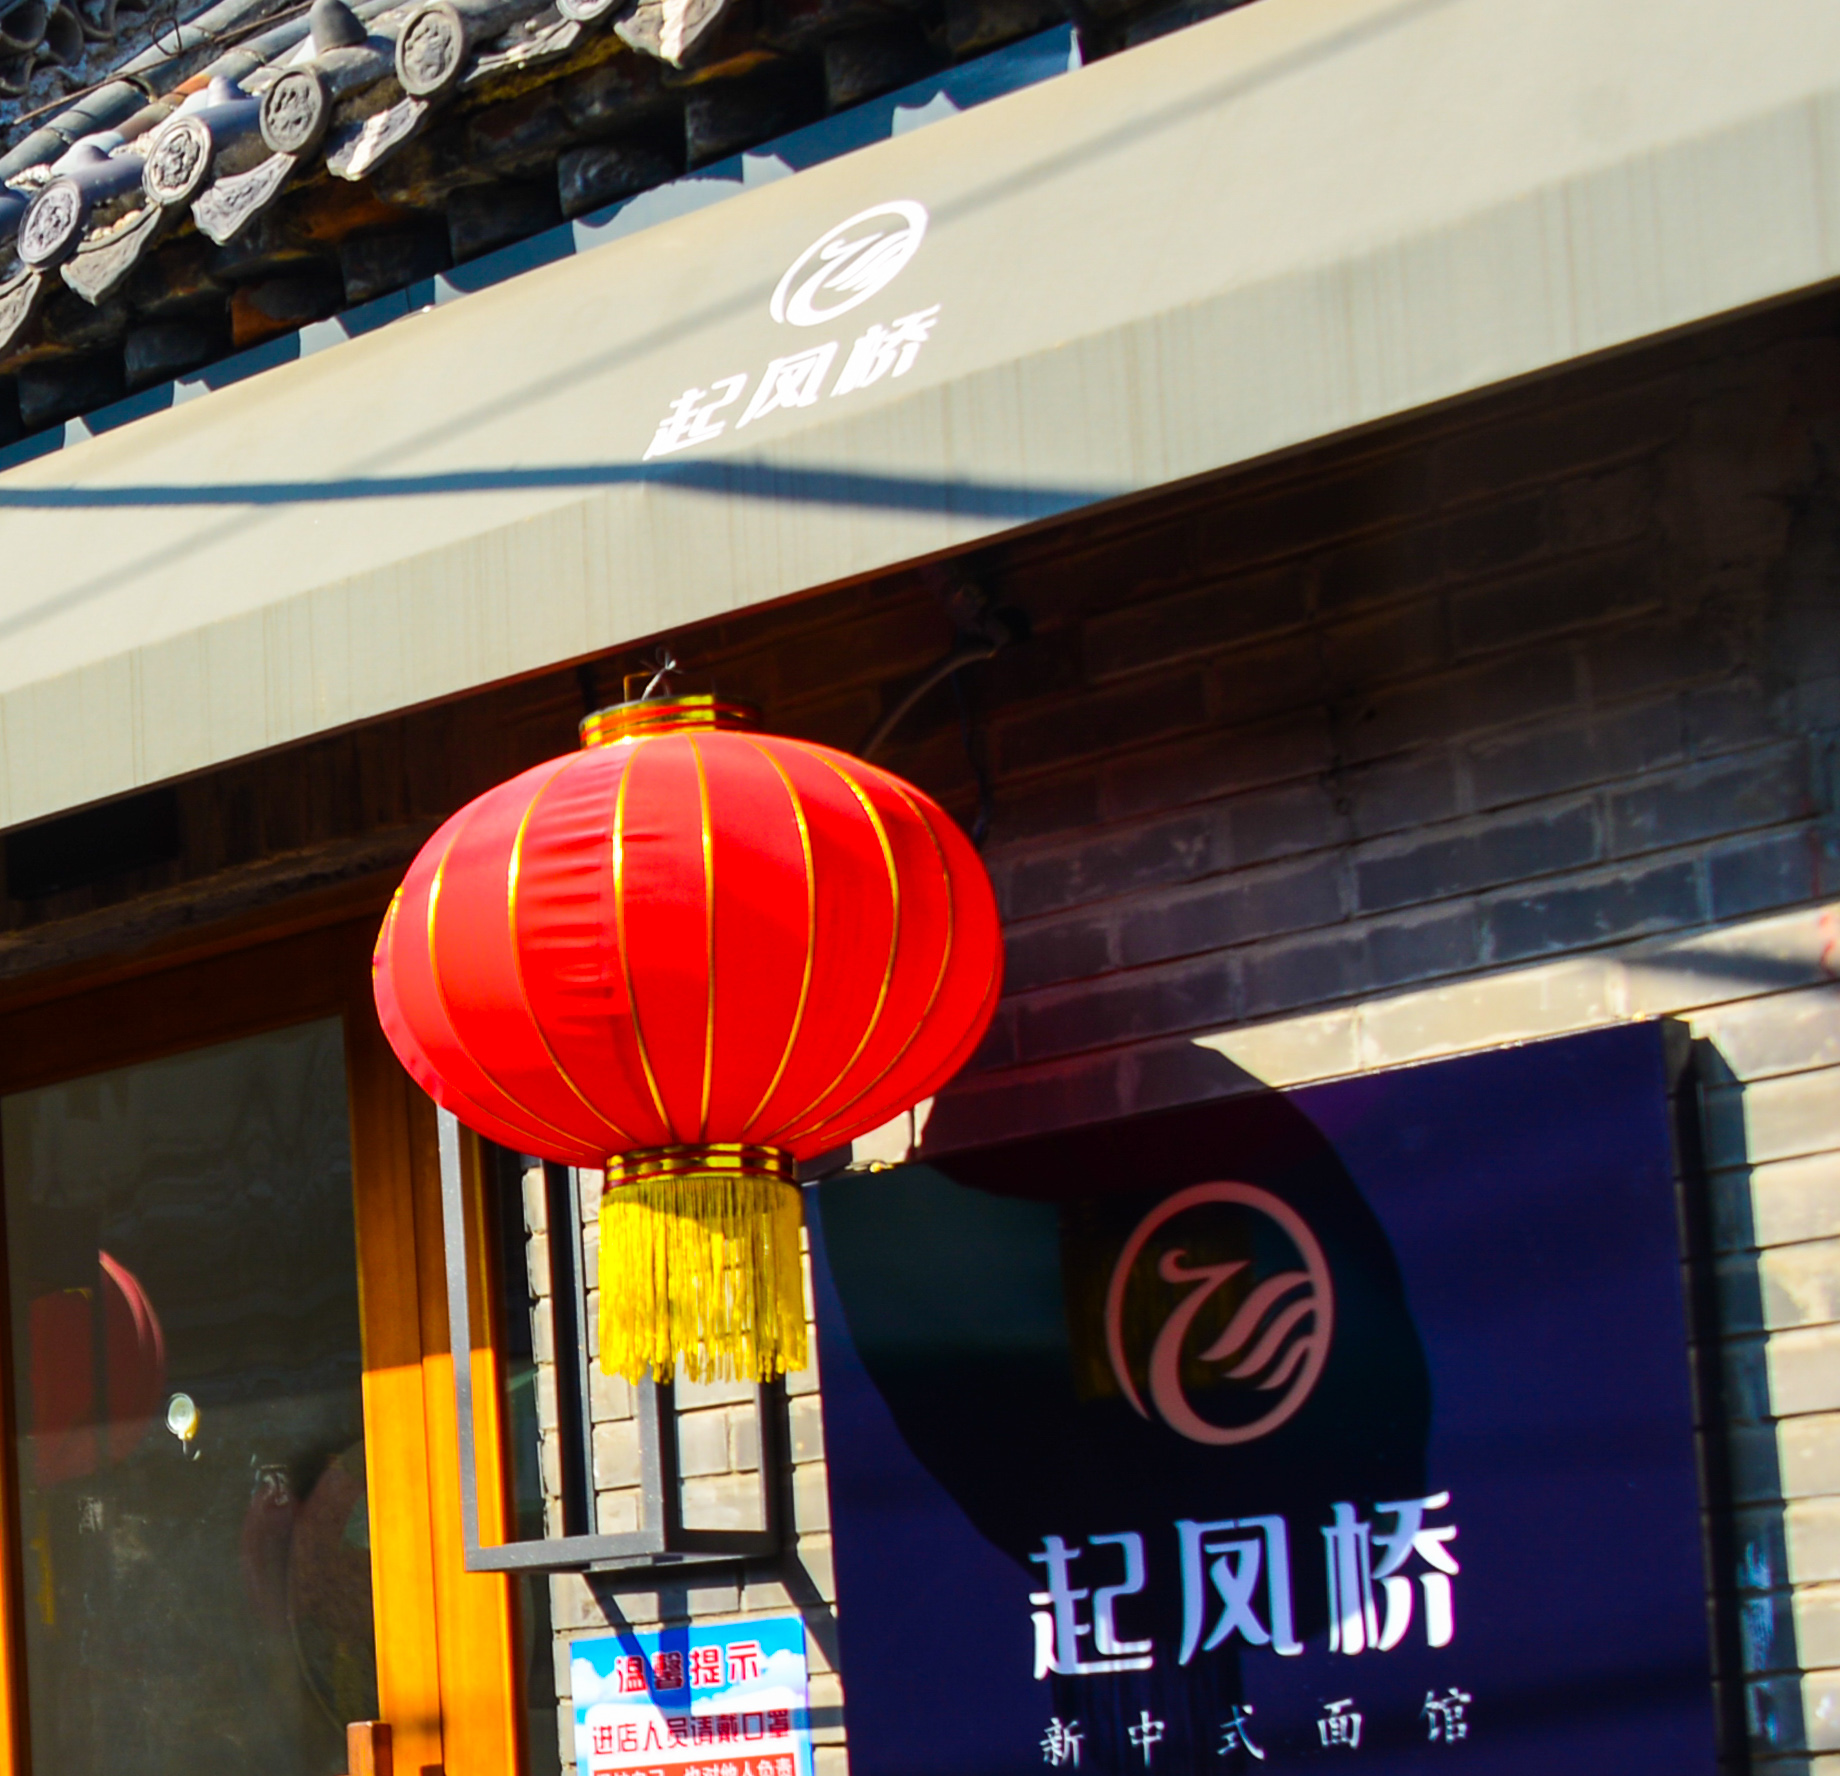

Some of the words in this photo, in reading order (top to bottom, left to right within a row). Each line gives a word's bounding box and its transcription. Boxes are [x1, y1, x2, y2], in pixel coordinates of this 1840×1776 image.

[642, 303, 941, 461] 起凤桥
[1028, 1489, 1460, 1681] 起凤桥
[616, 1641, 760, 1694] 温馨提示
[592, 1708, 790, 1756] 进店人员请戴口罩
[1039, 1687, 1474, 1769] 新中式面馆
